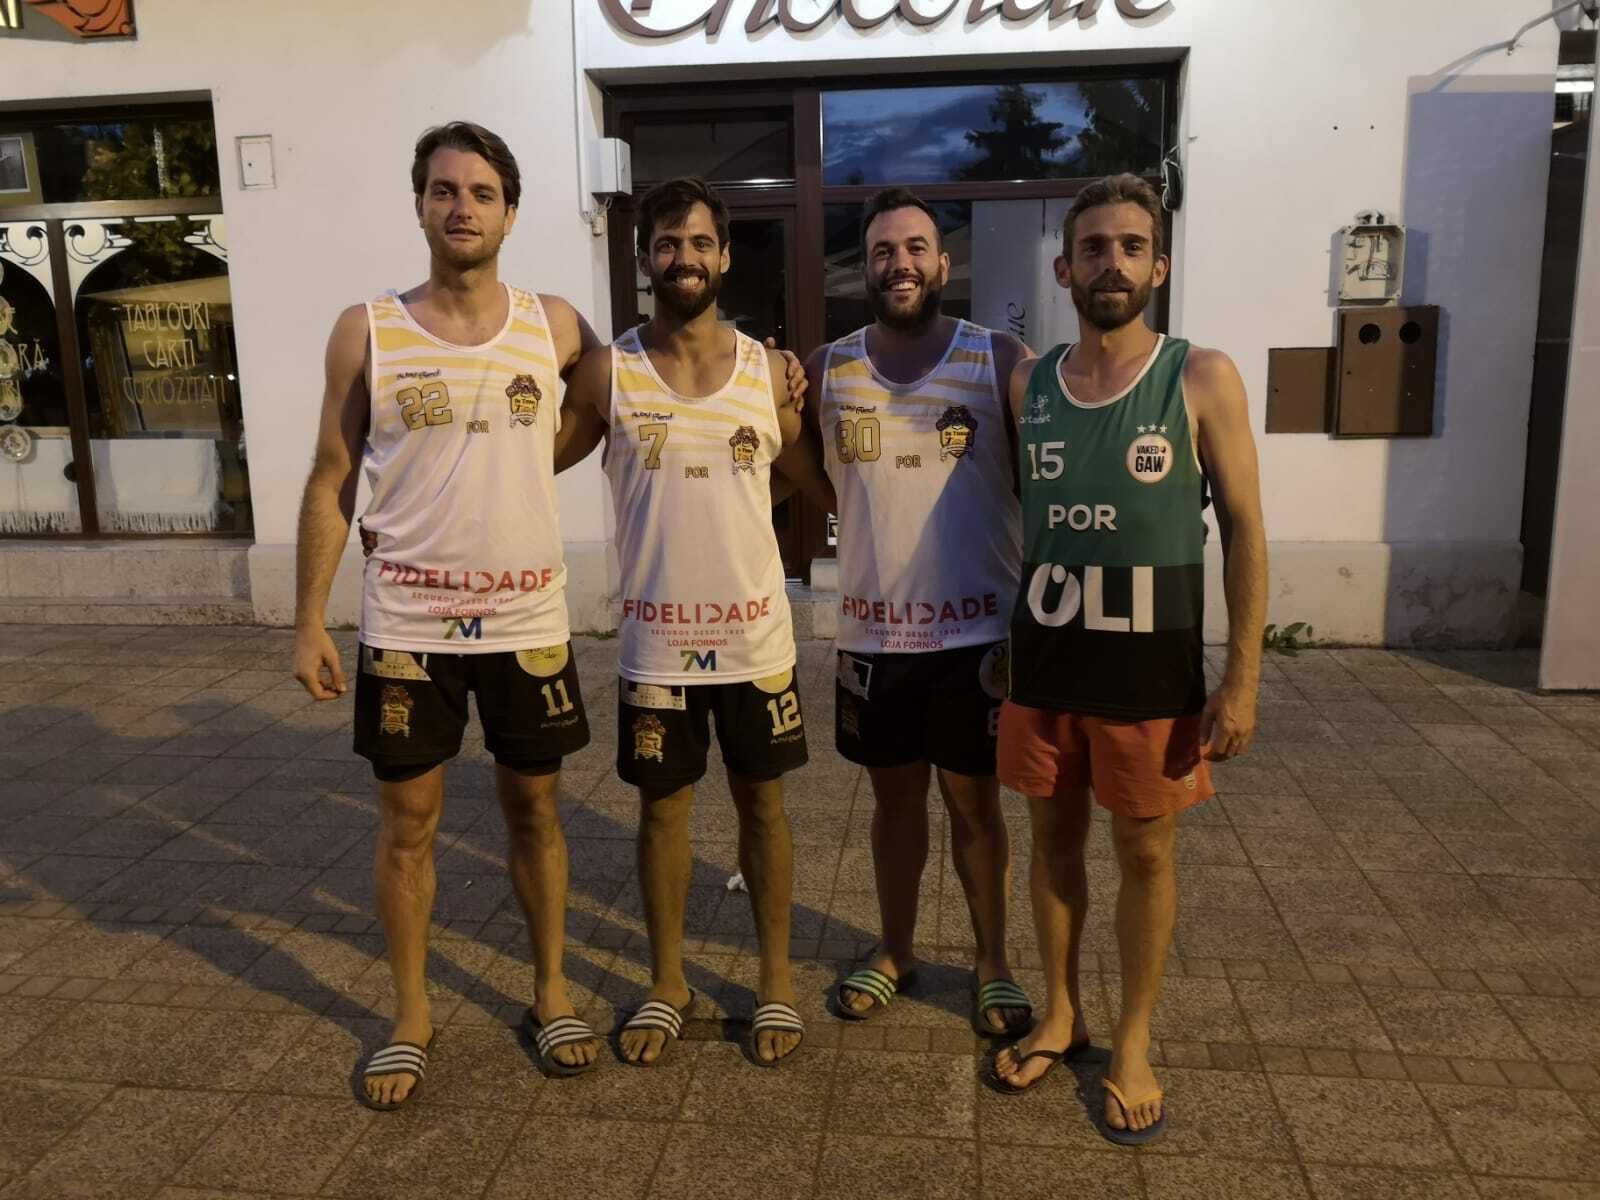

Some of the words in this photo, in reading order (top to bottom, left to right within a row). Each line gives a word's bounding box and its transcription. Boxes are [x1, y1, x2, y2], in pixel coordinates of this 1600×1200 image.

[122, 301, 210, 332] TABLOURI
[396, 381, 453, 430] 22
[467, 420, 489, 434] POR
[638, 422, 668, 470] 7
[685, 466, 709, 479] POR
[896, 455, 922, 468] POR
[1027, 441, 1066, 481] 15
[1135, 456, 1165, 473] GAW
[1048, 504, 1118, 531] POR
[377, 561, 553, 593] FIDELIDADE
[623, 596, 770, 624] FIDELIDADE
[842, 593, 998, 625] FIDELIDADE
[667, 639, 689, 647] LOJA
[691, 639, 728, 647] FORNOS
[880, 640, 901, 649] LOJA
[903, 640, 944, 649] FORNOS
[680, 650, 717, 671] 7M
[541, 679, 574, 717] 11
[767, 690, 801, 736] 12
